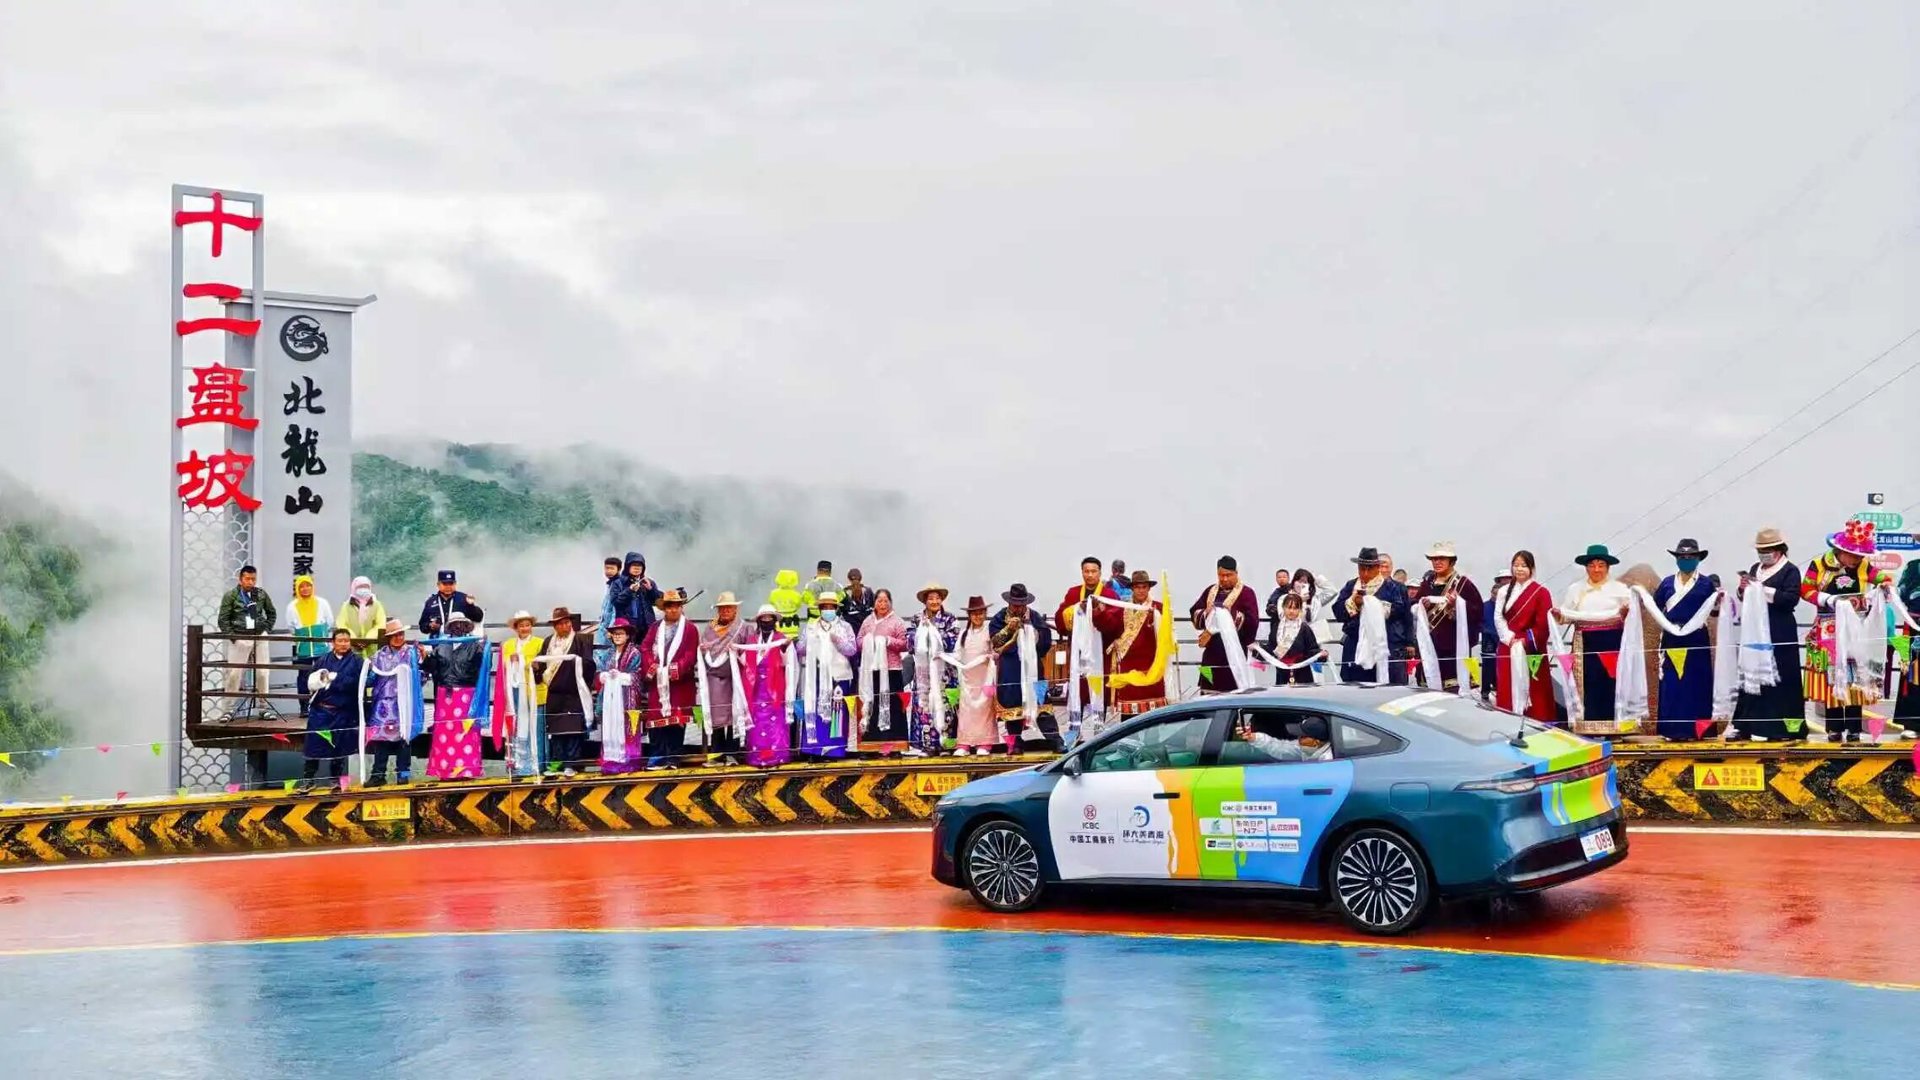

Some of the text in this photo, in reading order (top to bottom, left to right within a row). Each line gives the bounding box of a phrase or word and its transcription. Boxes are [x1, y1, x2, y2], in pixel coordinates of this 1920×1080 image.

[174, 191, 263, 512] 十二盘坡
[1082, 822, 1100, 830] ICBC
[1069, 834, 1116, 844] 中国工商银行
[1594, 830, 1613, 851] 089
